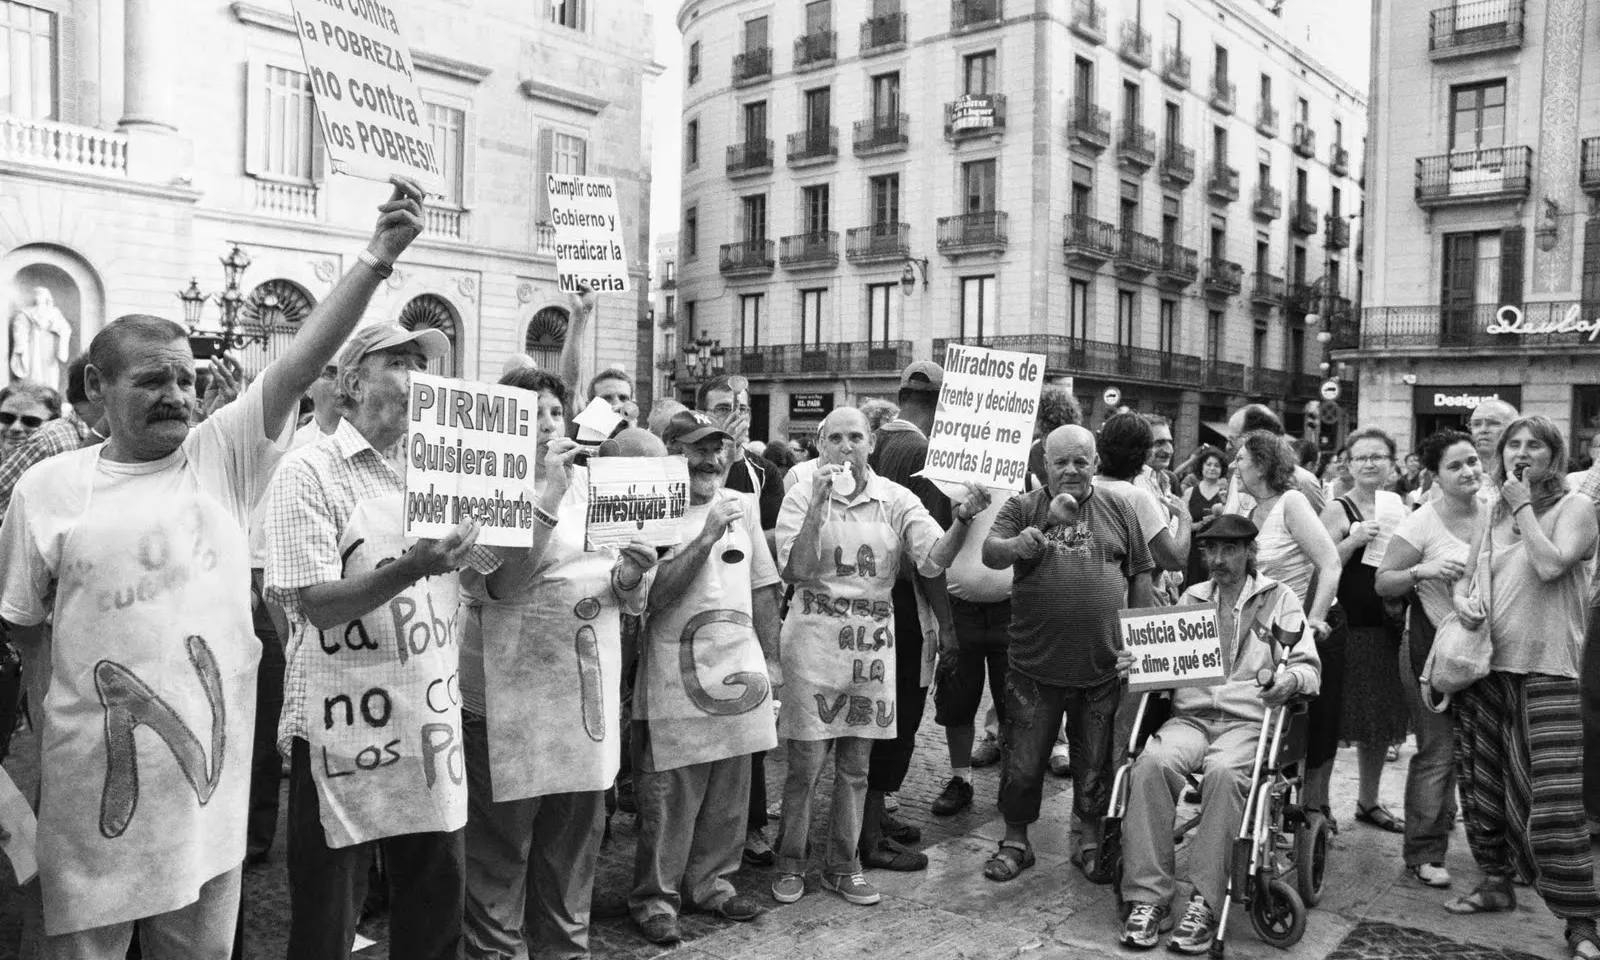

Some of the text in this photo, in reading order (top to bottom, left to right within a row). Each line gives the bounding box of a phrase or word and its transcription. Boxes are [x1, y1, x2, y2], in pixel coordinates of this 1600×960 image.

[296, 11, 412, 83] la POBREZA,
[310, 65, 420, 127] no contra
[322, 110, 439, 175] los POBRES!!
[548, 174, 612, 201] Cumplir como
[552, 207, 615, 232] Gobierno y
[556, 239, 622, 261] erradicar la
[1018, 357, 1038, 382] de
[411, 382, 529, 437] PIRMI:
[941, 382, 1035, 415] frente y decidnos
[932, 418, 1021, 445] porqué me
[410, 432, 528, 480] Quisiera no
[926, 447, 1026, 484] recortas la paga
[406, 483, 532, 532] poder necesitarte
[834, 544, 876, 577] LA
[1126, 615, 1218, 646] Justicia Social
[853, 659, 885, 684] LA
[1142, 654, 1169, 673] dime
[1173, 649, 1199, 676] ¿qué
[1202, 647, 1221, 668] es?
[323, 687, 392, 730] no
